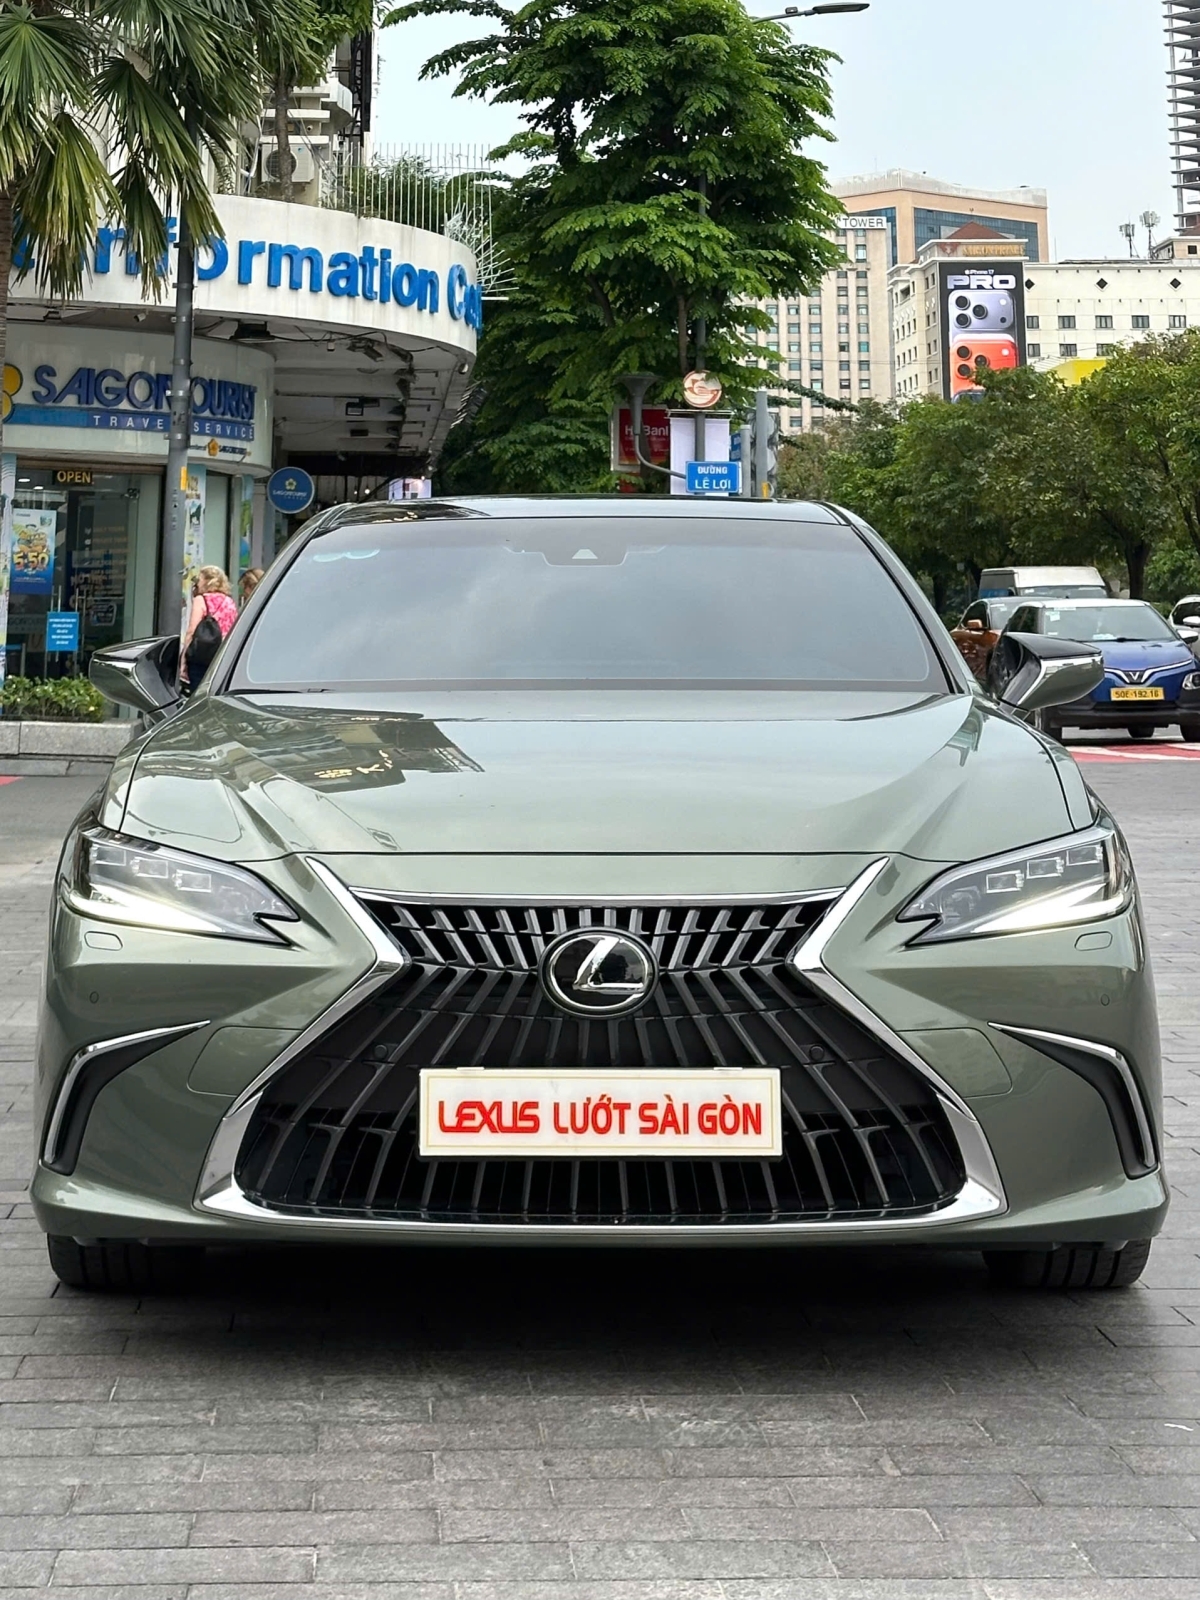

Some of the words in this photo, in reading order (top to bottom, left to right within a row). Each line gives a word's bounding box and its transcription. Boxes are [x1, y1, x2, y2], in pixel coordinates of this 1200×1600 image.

[842, 217, 884, 228] TOWER
[947, 275, 1016, 289] PRO
[32, 365, 257, 420] SAIGONOURIST
[193, 422, 254, 439] SERVICE
[57, 470, 91, 483] OPEN
[695, 477, 710, 489] LÊ
[712, 479, 731, 491] LỢI
[438, 1101, 540, 1133] LEXUS
[553, 1094, 632, 1135] LƯỚT
[638, 1095, 690, 1135] SÀI
[697, 1095, 762, 1135] GÒN
